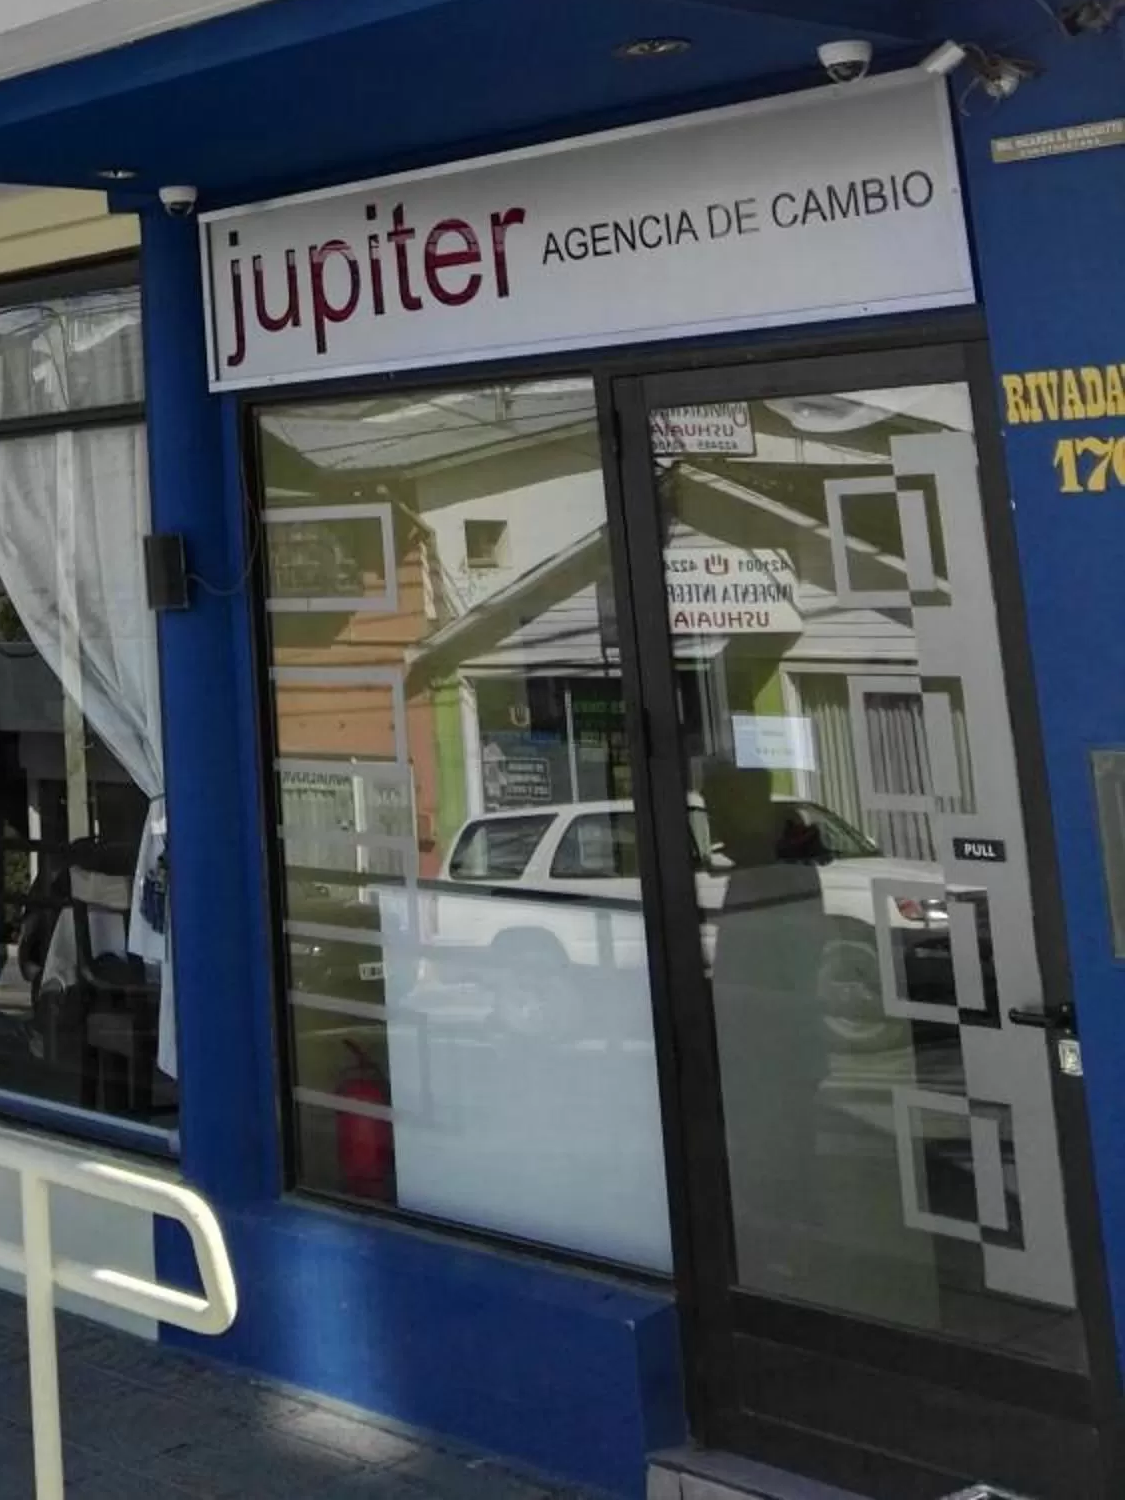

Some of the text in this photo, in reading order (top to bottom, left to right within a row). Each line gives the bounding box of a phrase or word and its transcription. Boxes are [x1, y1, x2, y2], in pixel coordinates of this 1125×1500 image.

[542, 169, 934, 265] AGENCIA DE CAMBIO
[227, 203, 525, 367] jupiter
[1002, 363, 1125, 425] RIVADA
[964, 842, 996, 858] PULL
